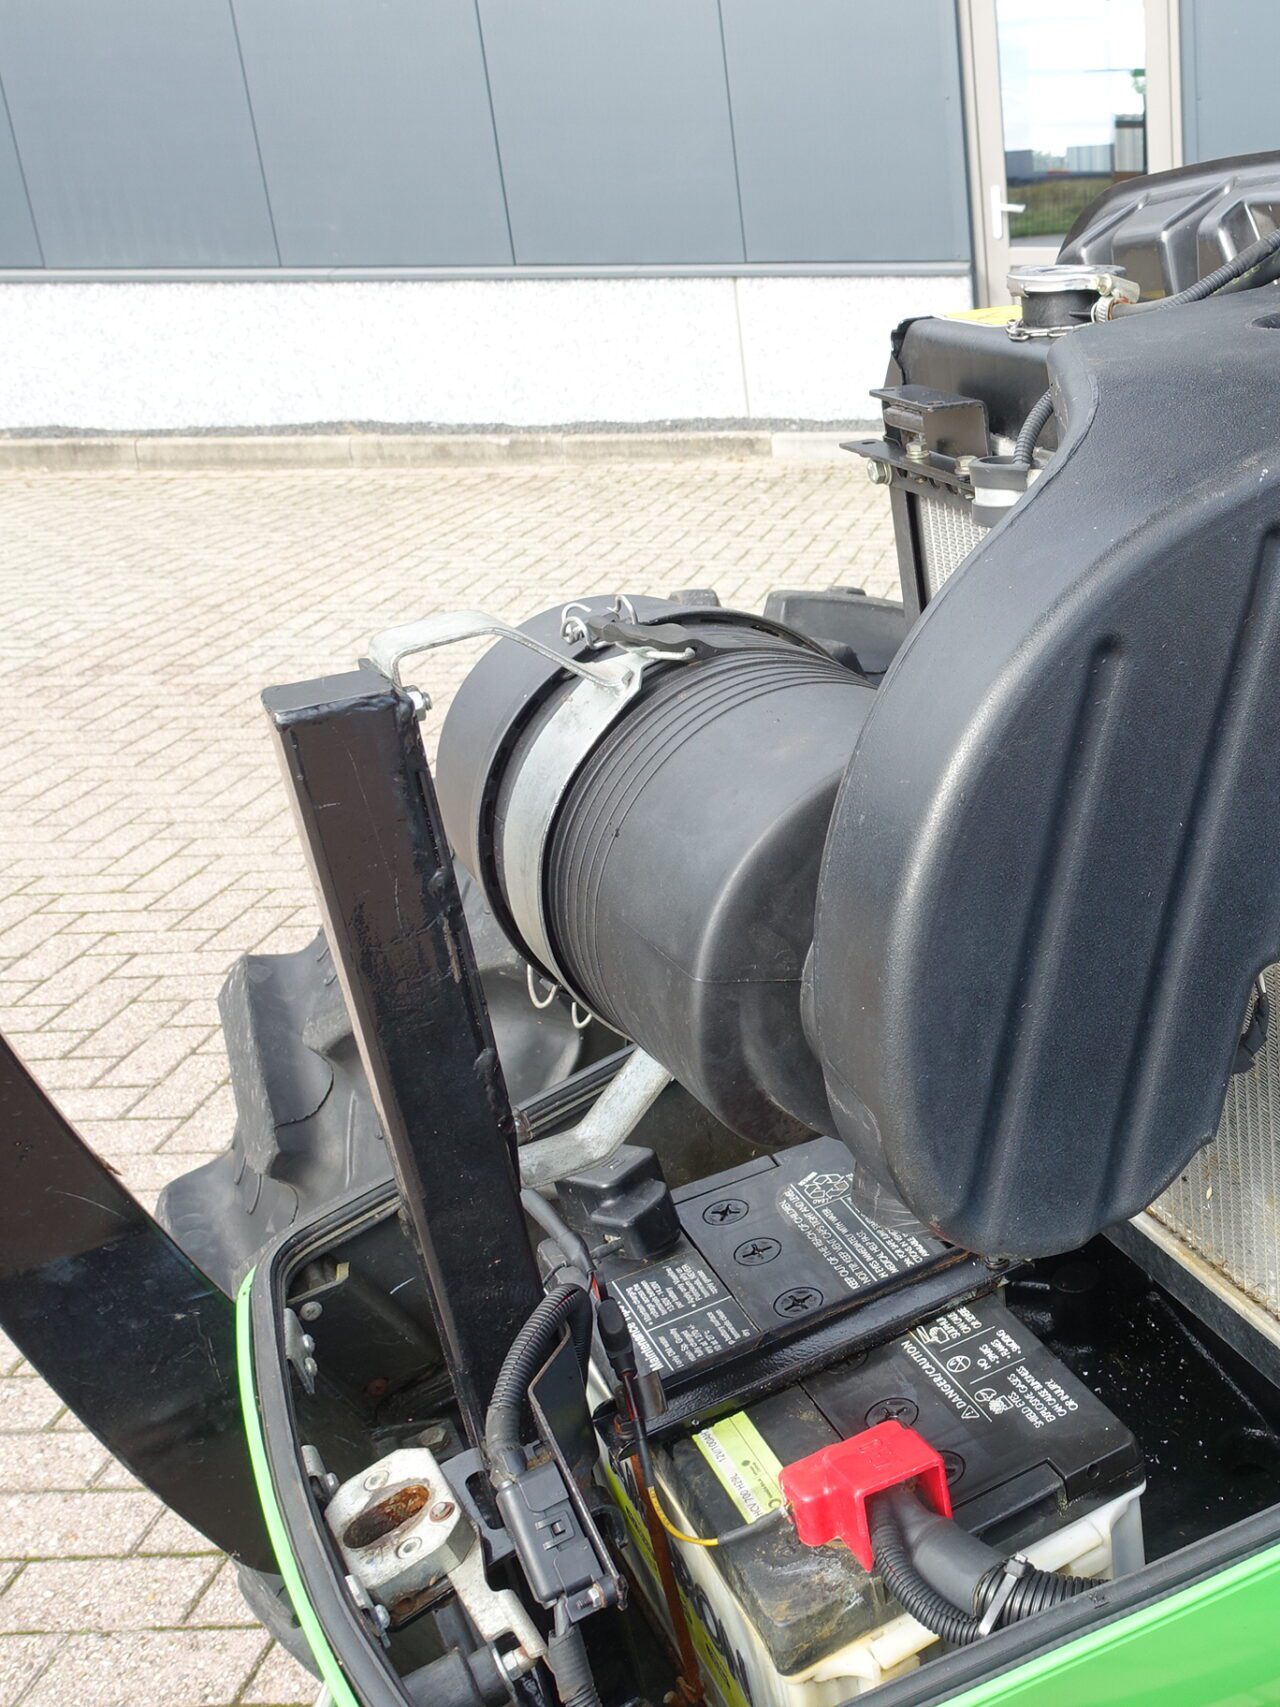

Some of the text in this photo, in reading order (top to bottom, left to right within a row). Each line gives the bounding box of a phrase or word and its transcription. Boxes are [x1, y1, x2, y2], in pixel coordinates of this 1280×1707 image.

[793, 1200, 809, 1214] AND
[796, 1220, 810, 1231] OF
[803, 1210, 821, 1227] TIGHT
[815, 1224, 832, 1239] CAPS
[833, 1220, 849, 1234] WITH
[804, 1229, 824, 1247] REACH
[826, 1236, 844, 1252] VENT
[817, 1244, 832, 1257] THE
[843, 1231, 874, 1262] IMMEDIATELY
[865, 1239, 881, 1253] HELP
[825, 1254, 840, 1265] OF
[837, 1249, 853, 1264] KEEP
[875, 1250, 899, 1274] MEDICAL
[833, 1263, 850, 1277] OUT
[868, 1259, 885, 1273] EYES
[843, 1275, 861, 1290] KEEP
[853, 1268, 871, 1284] NOT
[955, 1321, 973, 1334] CAN
[974, 1356, 993, 1370] NO
[899, 1338, 968, 1409] DANGER/CAUTION
[1004, 1372, 1058, 1423] EXPLOSIVE GASES
[1014, 1364, 1069, 1417] CAN CAUSE BLINDNESS
[1062, 1396, 1081, 1411] OR
[1018, 1405, 1046, 1428] SHIELD
[738, 1487, 755, 1503] 700
[746, 1500, 764, 1517] HCV
